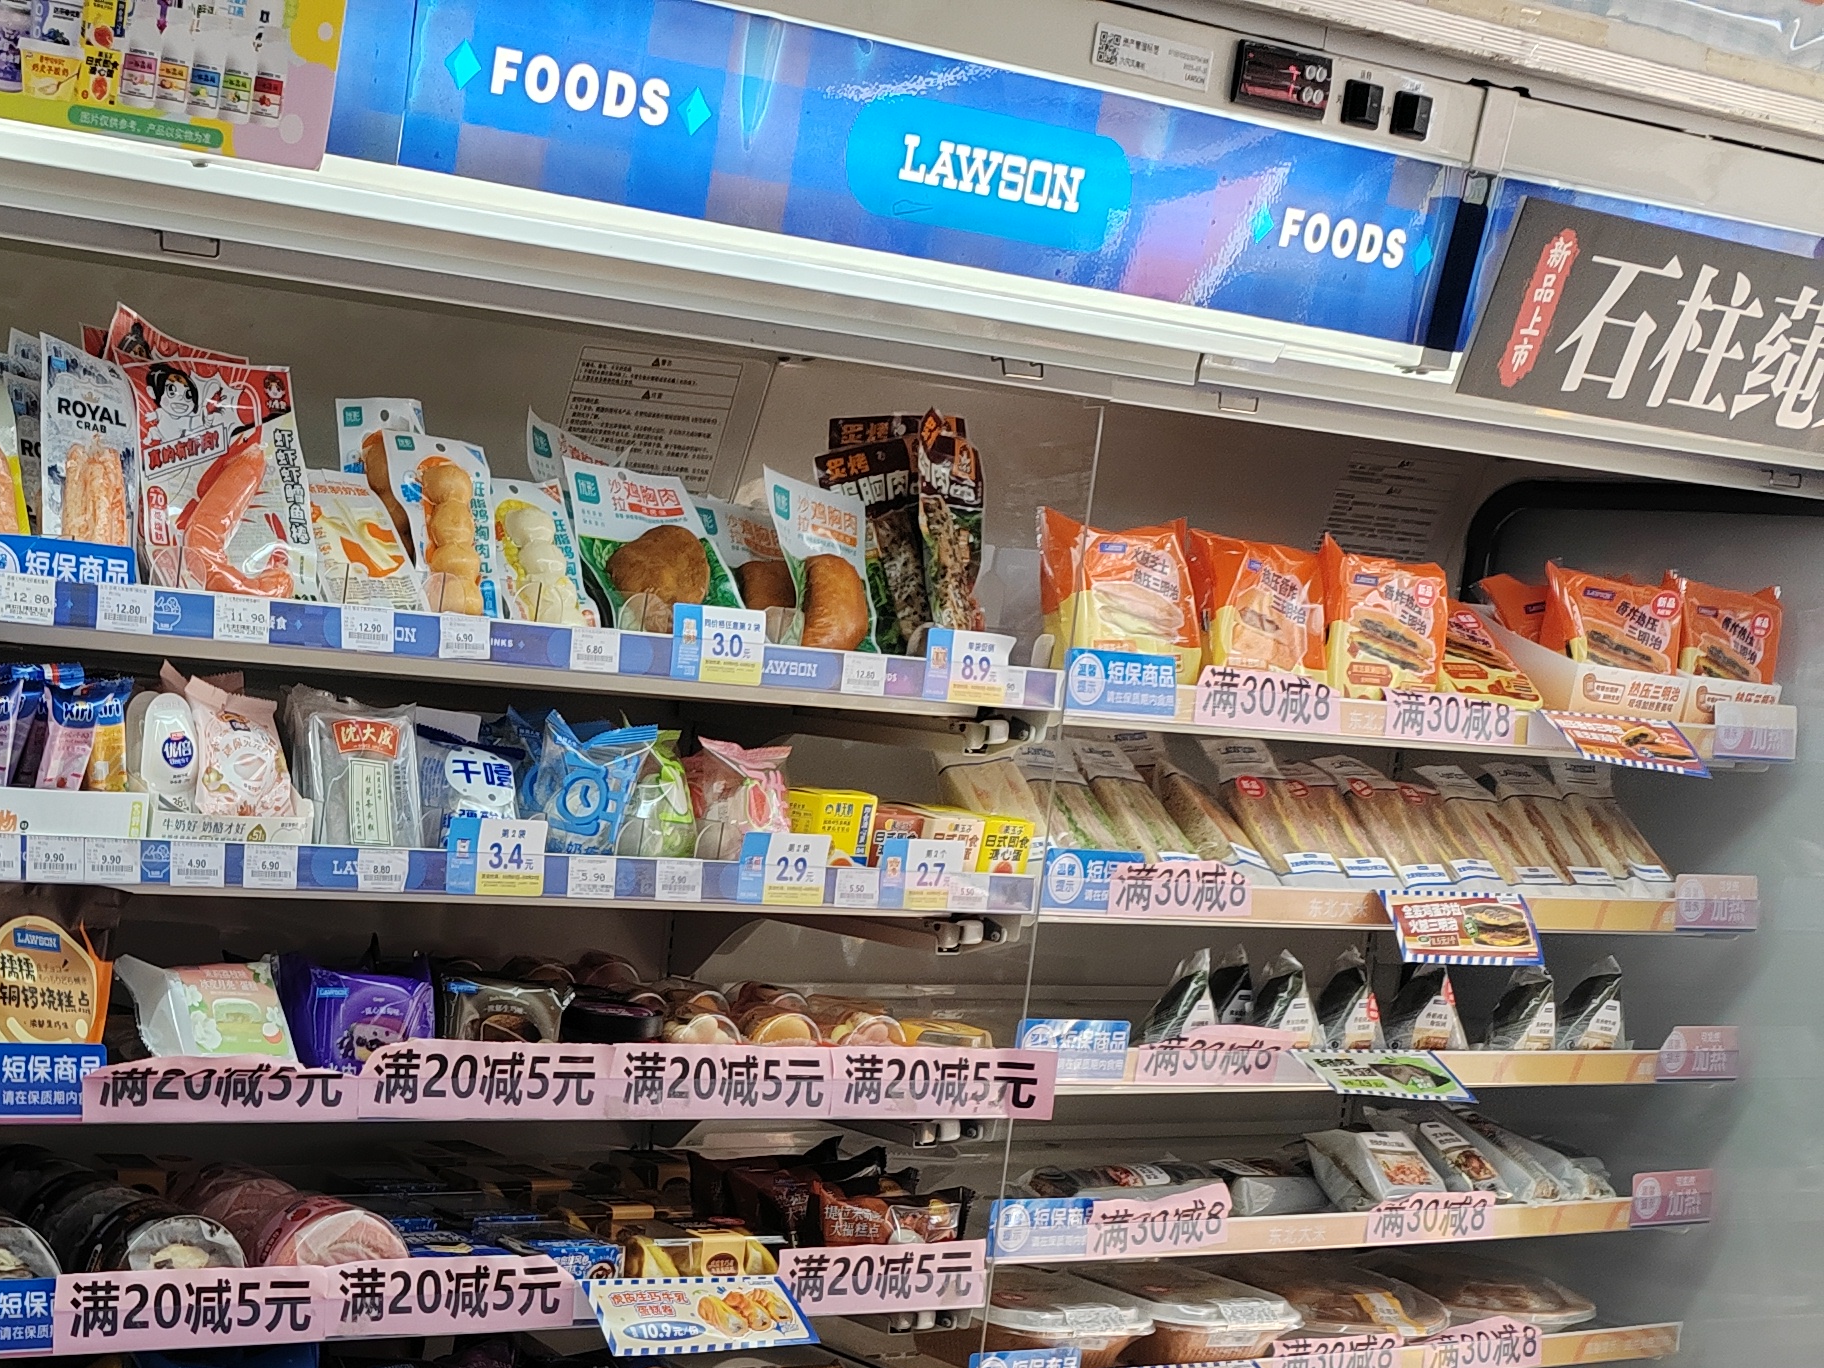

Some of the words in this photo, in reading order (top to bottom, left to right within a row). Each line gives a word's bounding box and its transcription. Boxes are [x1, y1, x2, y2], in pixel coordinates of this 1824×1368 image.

[490, 47, 670, 126] FOODS
[897, 134, 1085, 212] LAWSON
[1278, 208, 1407, 269] FOODS
[1511, 235, 1573, 369] 新品上市
[58, 397, 127, 427] ROYAL
[625, 478, 681, 507] 鸡胸肉
[25, 549, 129, 584] 短保商品
[12, 592, 50, 605] 12.80
[115, 603, 141, 615] 12.80
[231, 611, 266, 623] 11.90
[358, 623, 382, 633] 12.90
[586, 645, 603, 655] 6.80
[1108, 661, 1174, 688] 短保商品
[1198, 670, 1332, 723] 满30减8
[1391, 694, 1511, 741] 满30减8
[43, 852, 64, 863] 9.90
[188, 859, 207, 869] 4.90
[261, 861, 280, 871] 6.90
[373, 865, 391, 874] 8.80
[1115, 862, 1248, 910] 满30减8
[17, 932, 58, 949] LAWSON
[2, 1055, 100, 1083] 短保商品
[100, 1064, 344, 1108] 满20减5元
[374, 1052, 596, 1108] 满20减5元
[625, 1052, 824, 1108] 满20减5元
[845, 1054, 1037, 1109] 满20减5元
[1094, 1195, 1224, 1254] 满30减8
[1373, 1194, 1488, 1240] 满30减8
[339, 1263, 561, 1325] 满20减5元
[790, 1251, 973, 1302] 满20减5元
[71, 1279, 312, 1338] 满20减5元
